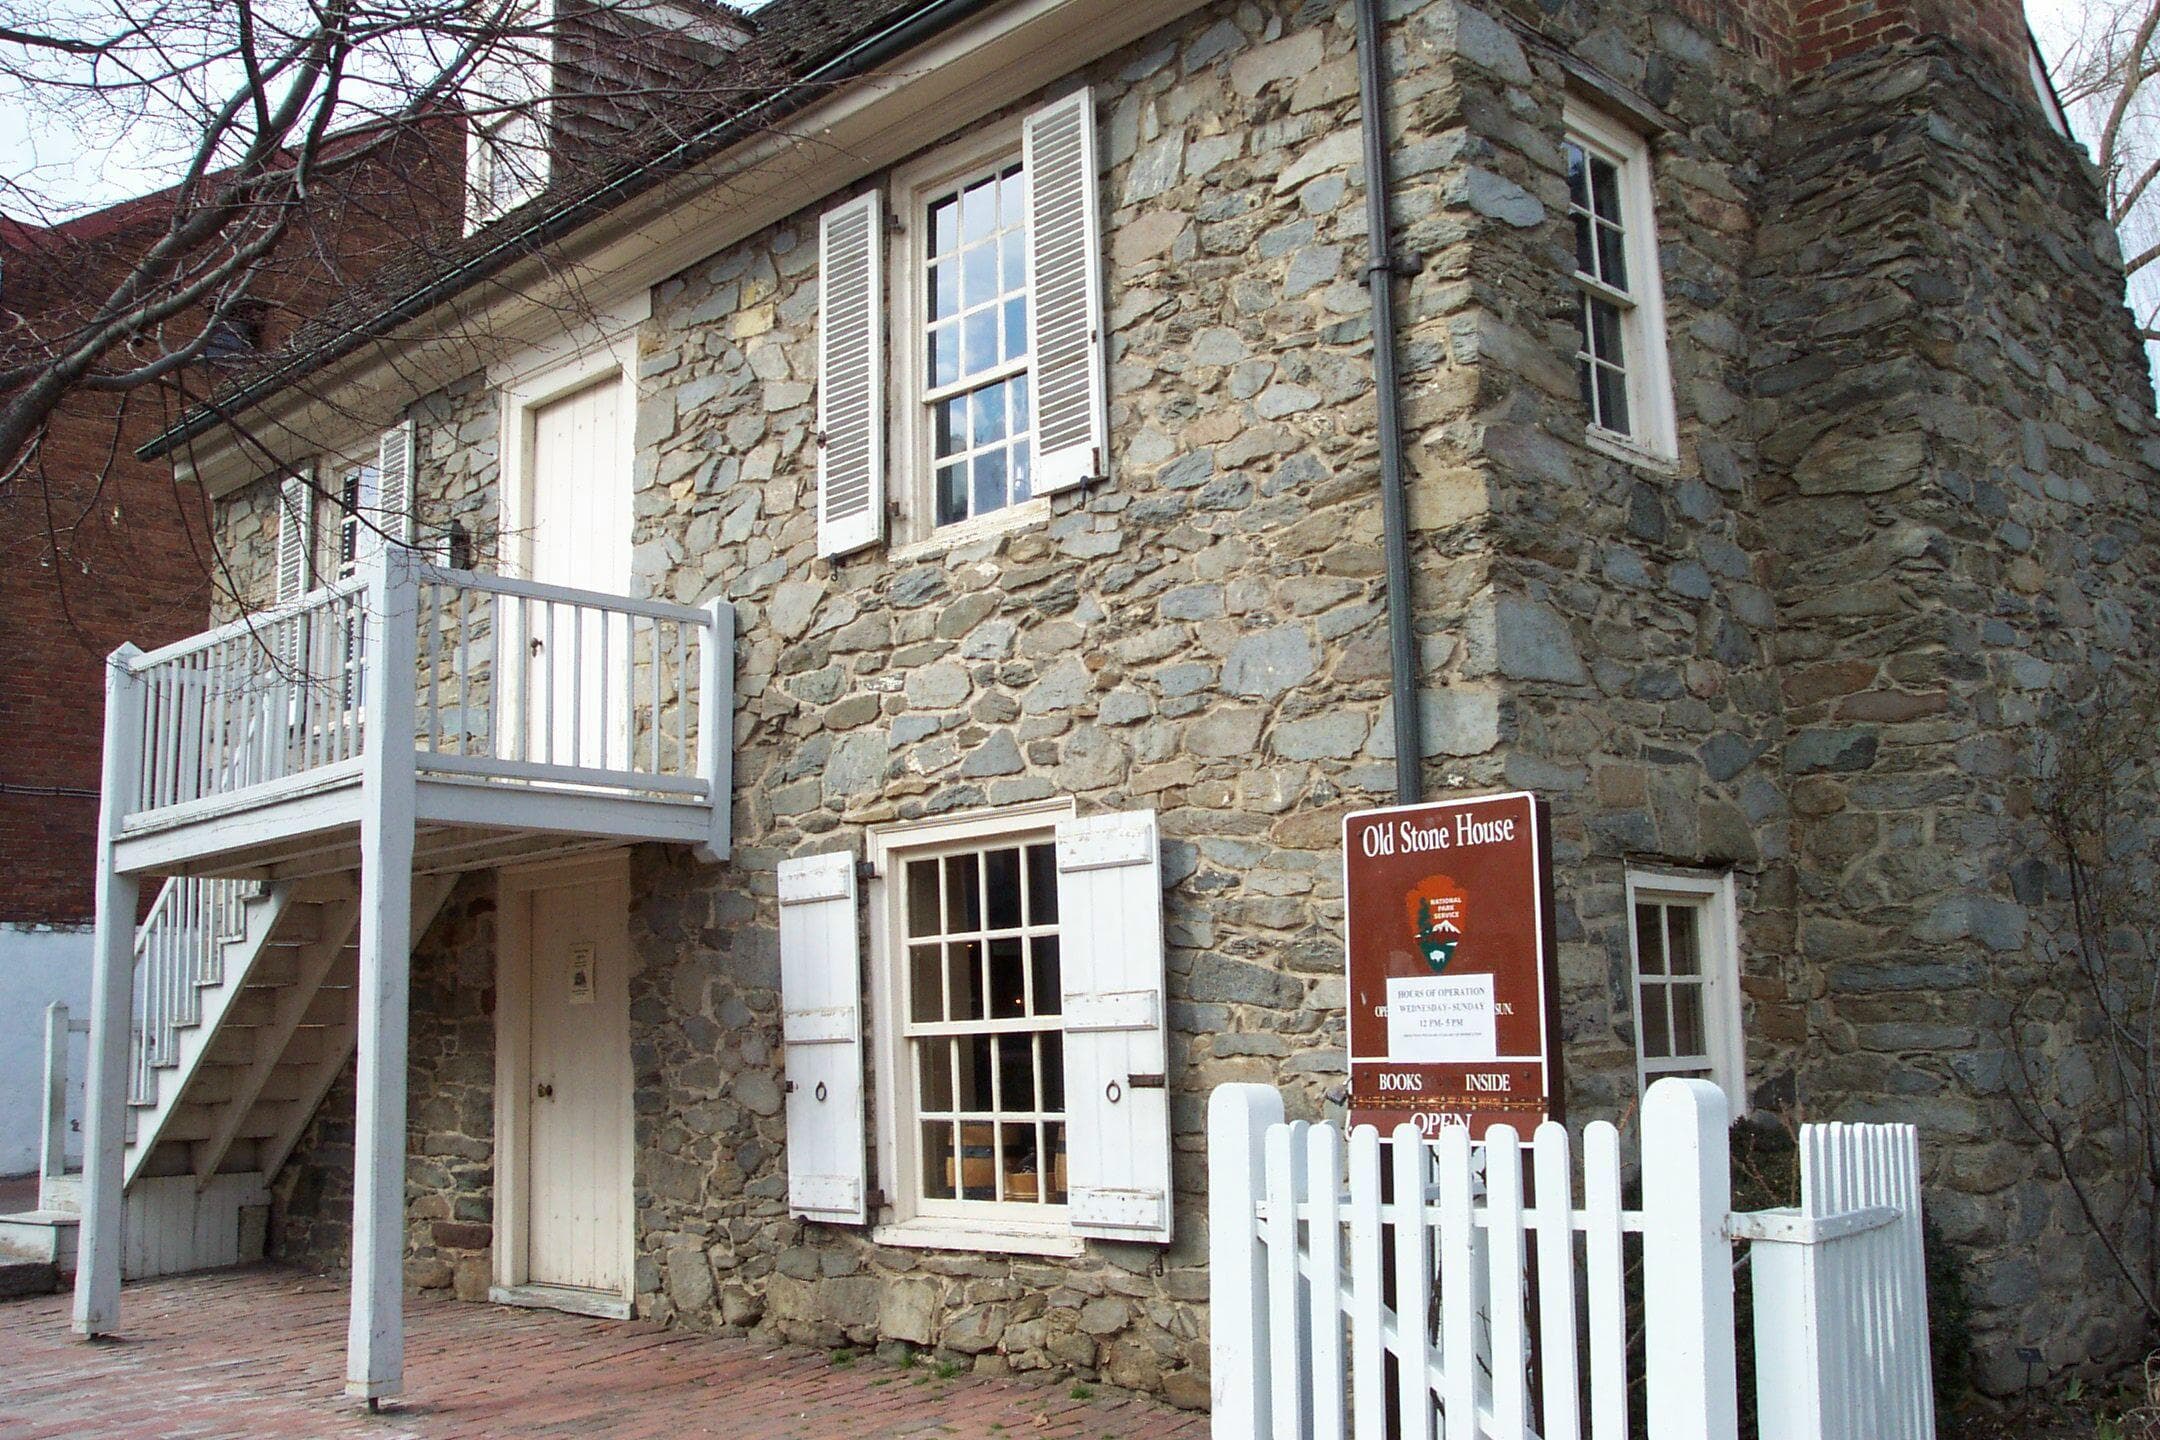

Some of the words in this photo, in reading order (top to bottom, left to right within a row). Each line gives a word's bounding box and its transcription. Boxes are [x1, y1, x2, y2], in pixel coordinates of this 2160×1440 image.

[1362, 821, 1395, 857] Old
[1400, 820, 1450, 854] Stone
[1455, 812, 1515, 847] House
[1430, 897, 1462, 905] NATIONAL
[1438, 904, 1455, 912] PARK
[1433, 911, 1460, 919] SERVICE
[1398, 990, 1423, 999] HOURS
[1425, 988, 1435, 997] OF
[1437, 987, 1485, 997] OPERATION
[1419, 1019, 1427, 1027] 12
[1451, 1018, 1464, 1027] PM
[1379, 1073, 1422, 1091] BOOKS
[1465, 1073, 1511, 1092] INSIDE
